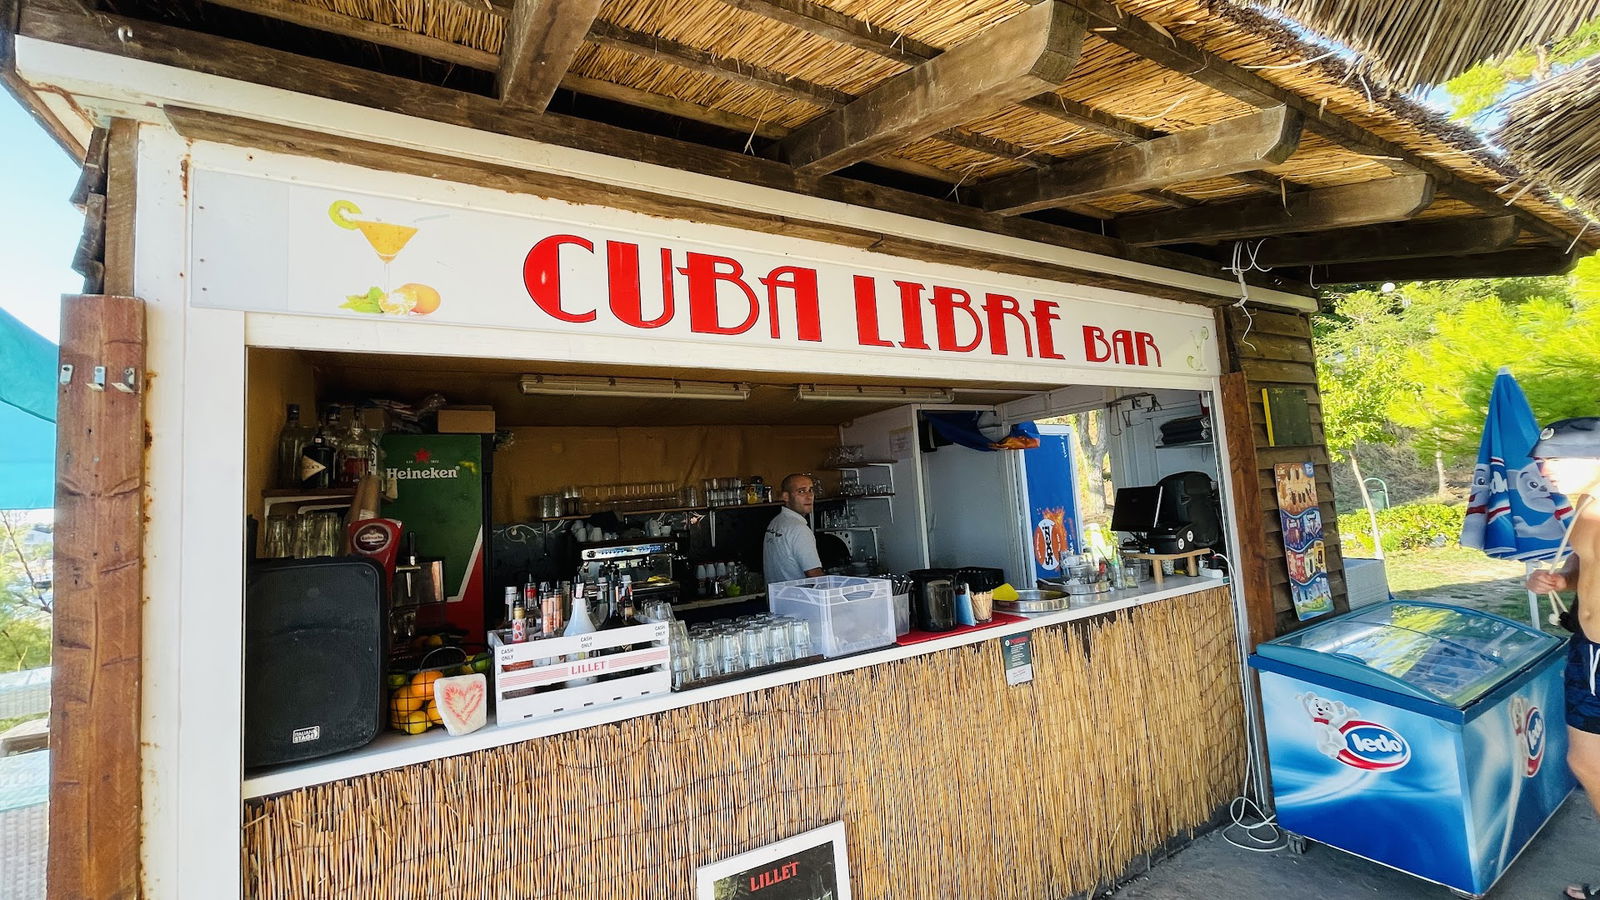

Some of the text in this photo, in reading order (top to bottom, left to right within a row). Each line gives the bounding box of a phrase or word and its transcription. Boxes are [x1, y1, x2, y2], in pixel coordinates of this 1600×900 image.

[523, 234, 1162, 367] CUBA LIBRE BAR
[386, 467, 458, 479] Heineken
[571, 660, 606, 674] LILLET
[750, 861, 800, 892] LILLET
